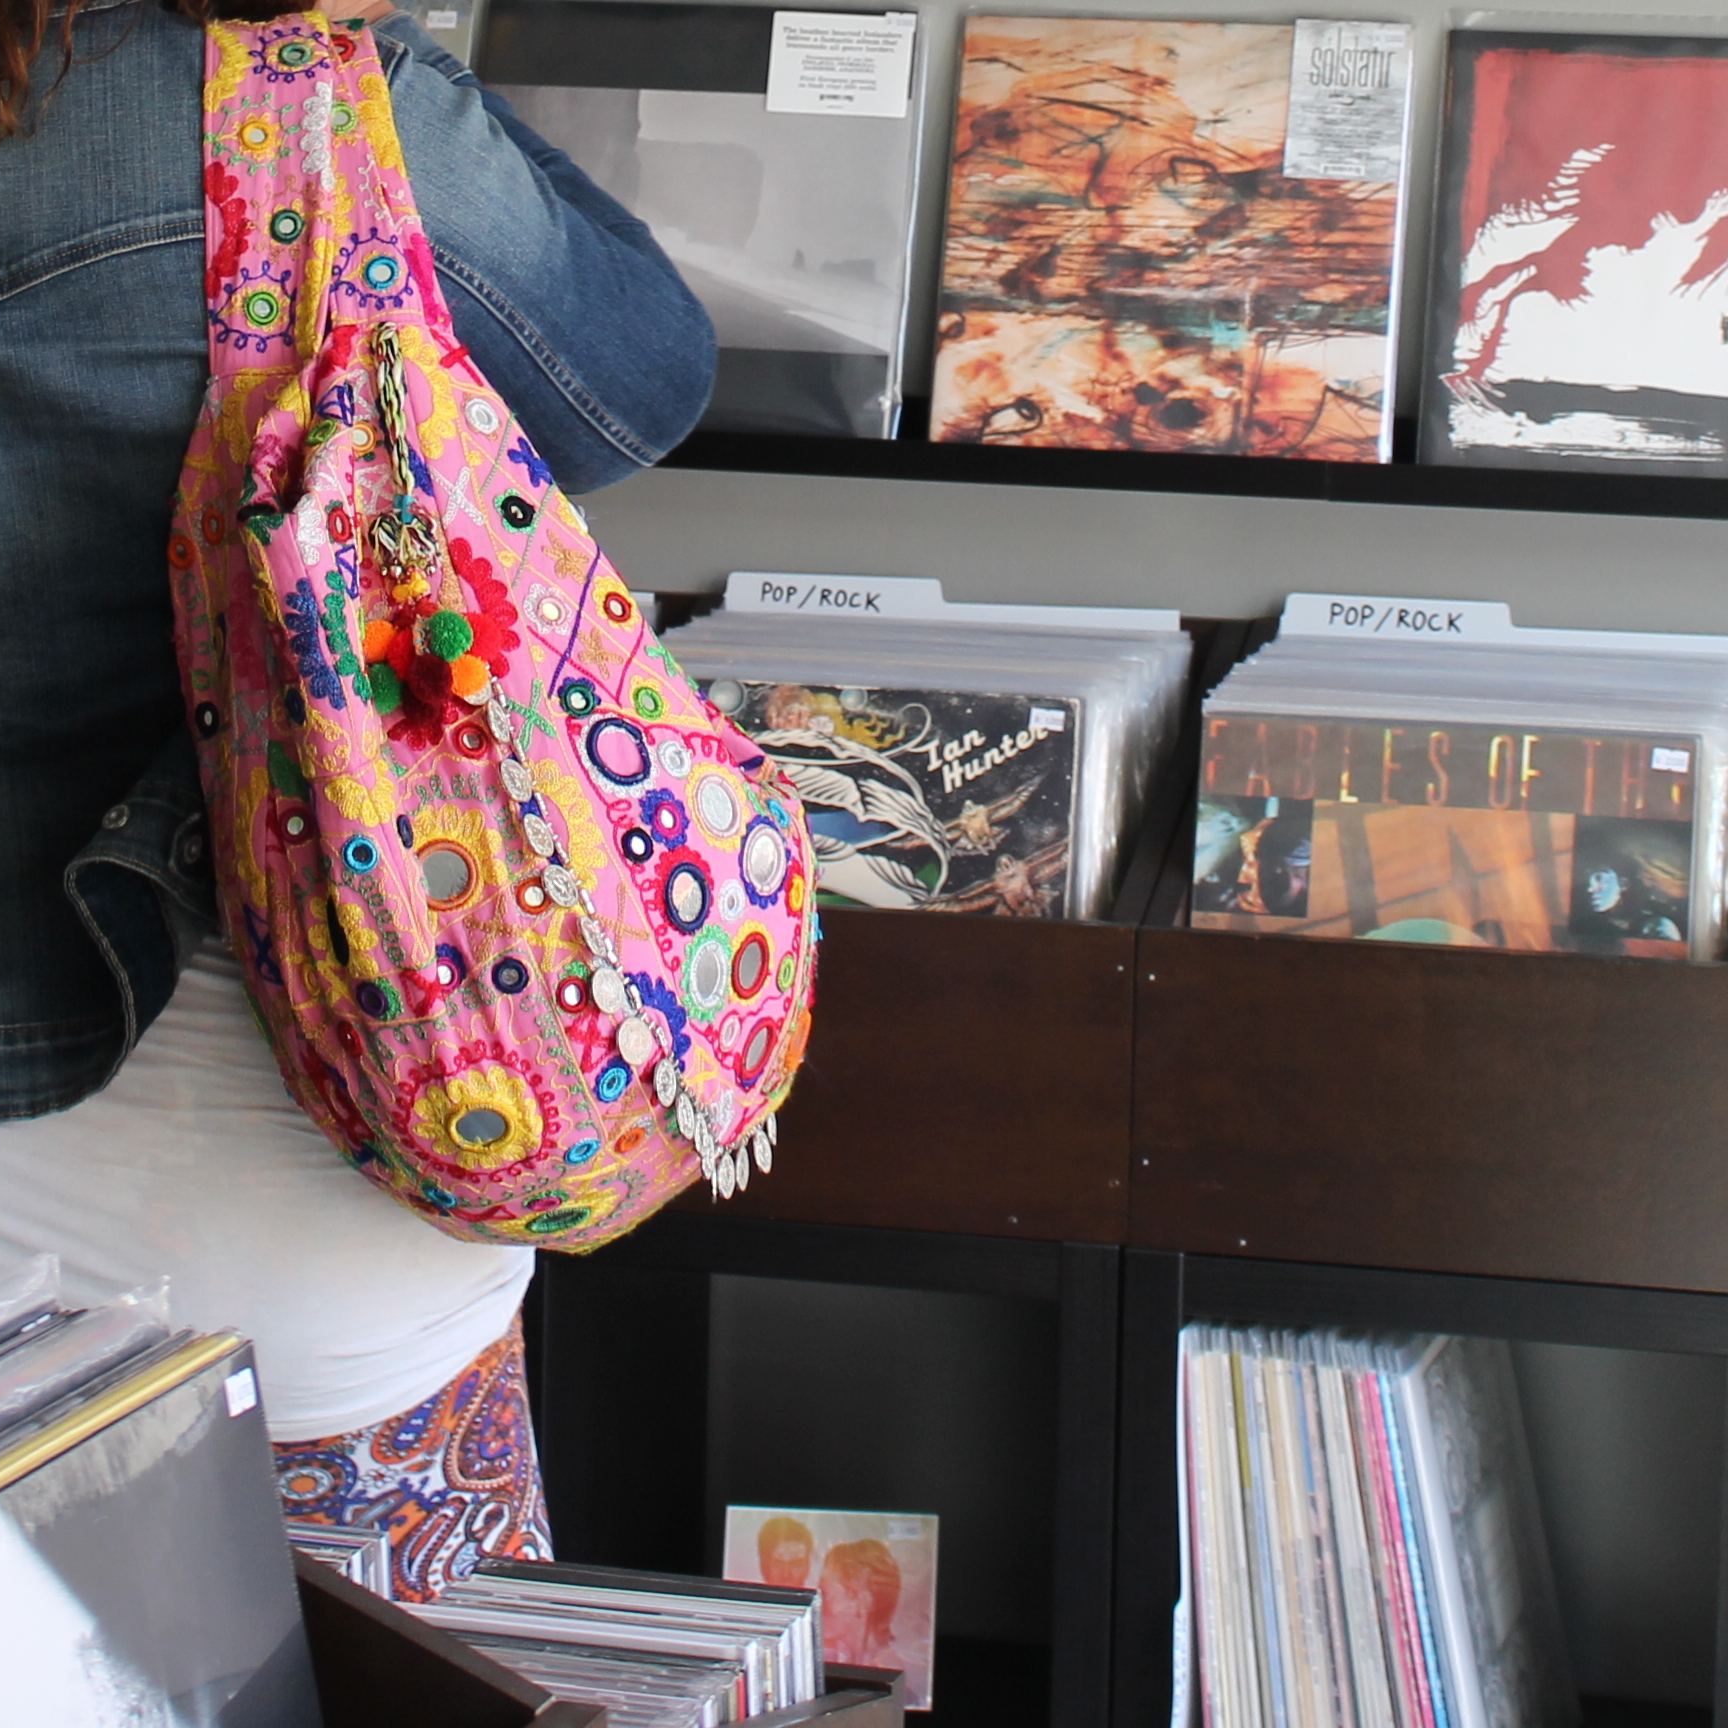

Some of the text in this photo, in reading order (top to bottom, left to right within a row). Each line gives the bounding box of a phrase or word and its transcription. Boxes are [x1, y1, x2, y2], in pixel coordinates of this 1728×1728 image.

[759, 580, 881, 614] POP/ROCK
[1327, 601, 1464, 633] POP/ROCK
[927, 729, 986, 772] Ian
[941, 728, 1050, 794] Hunter
[1203, 718, 1453, 806] FABLES
[1486, 731, 1541, 810] OF
